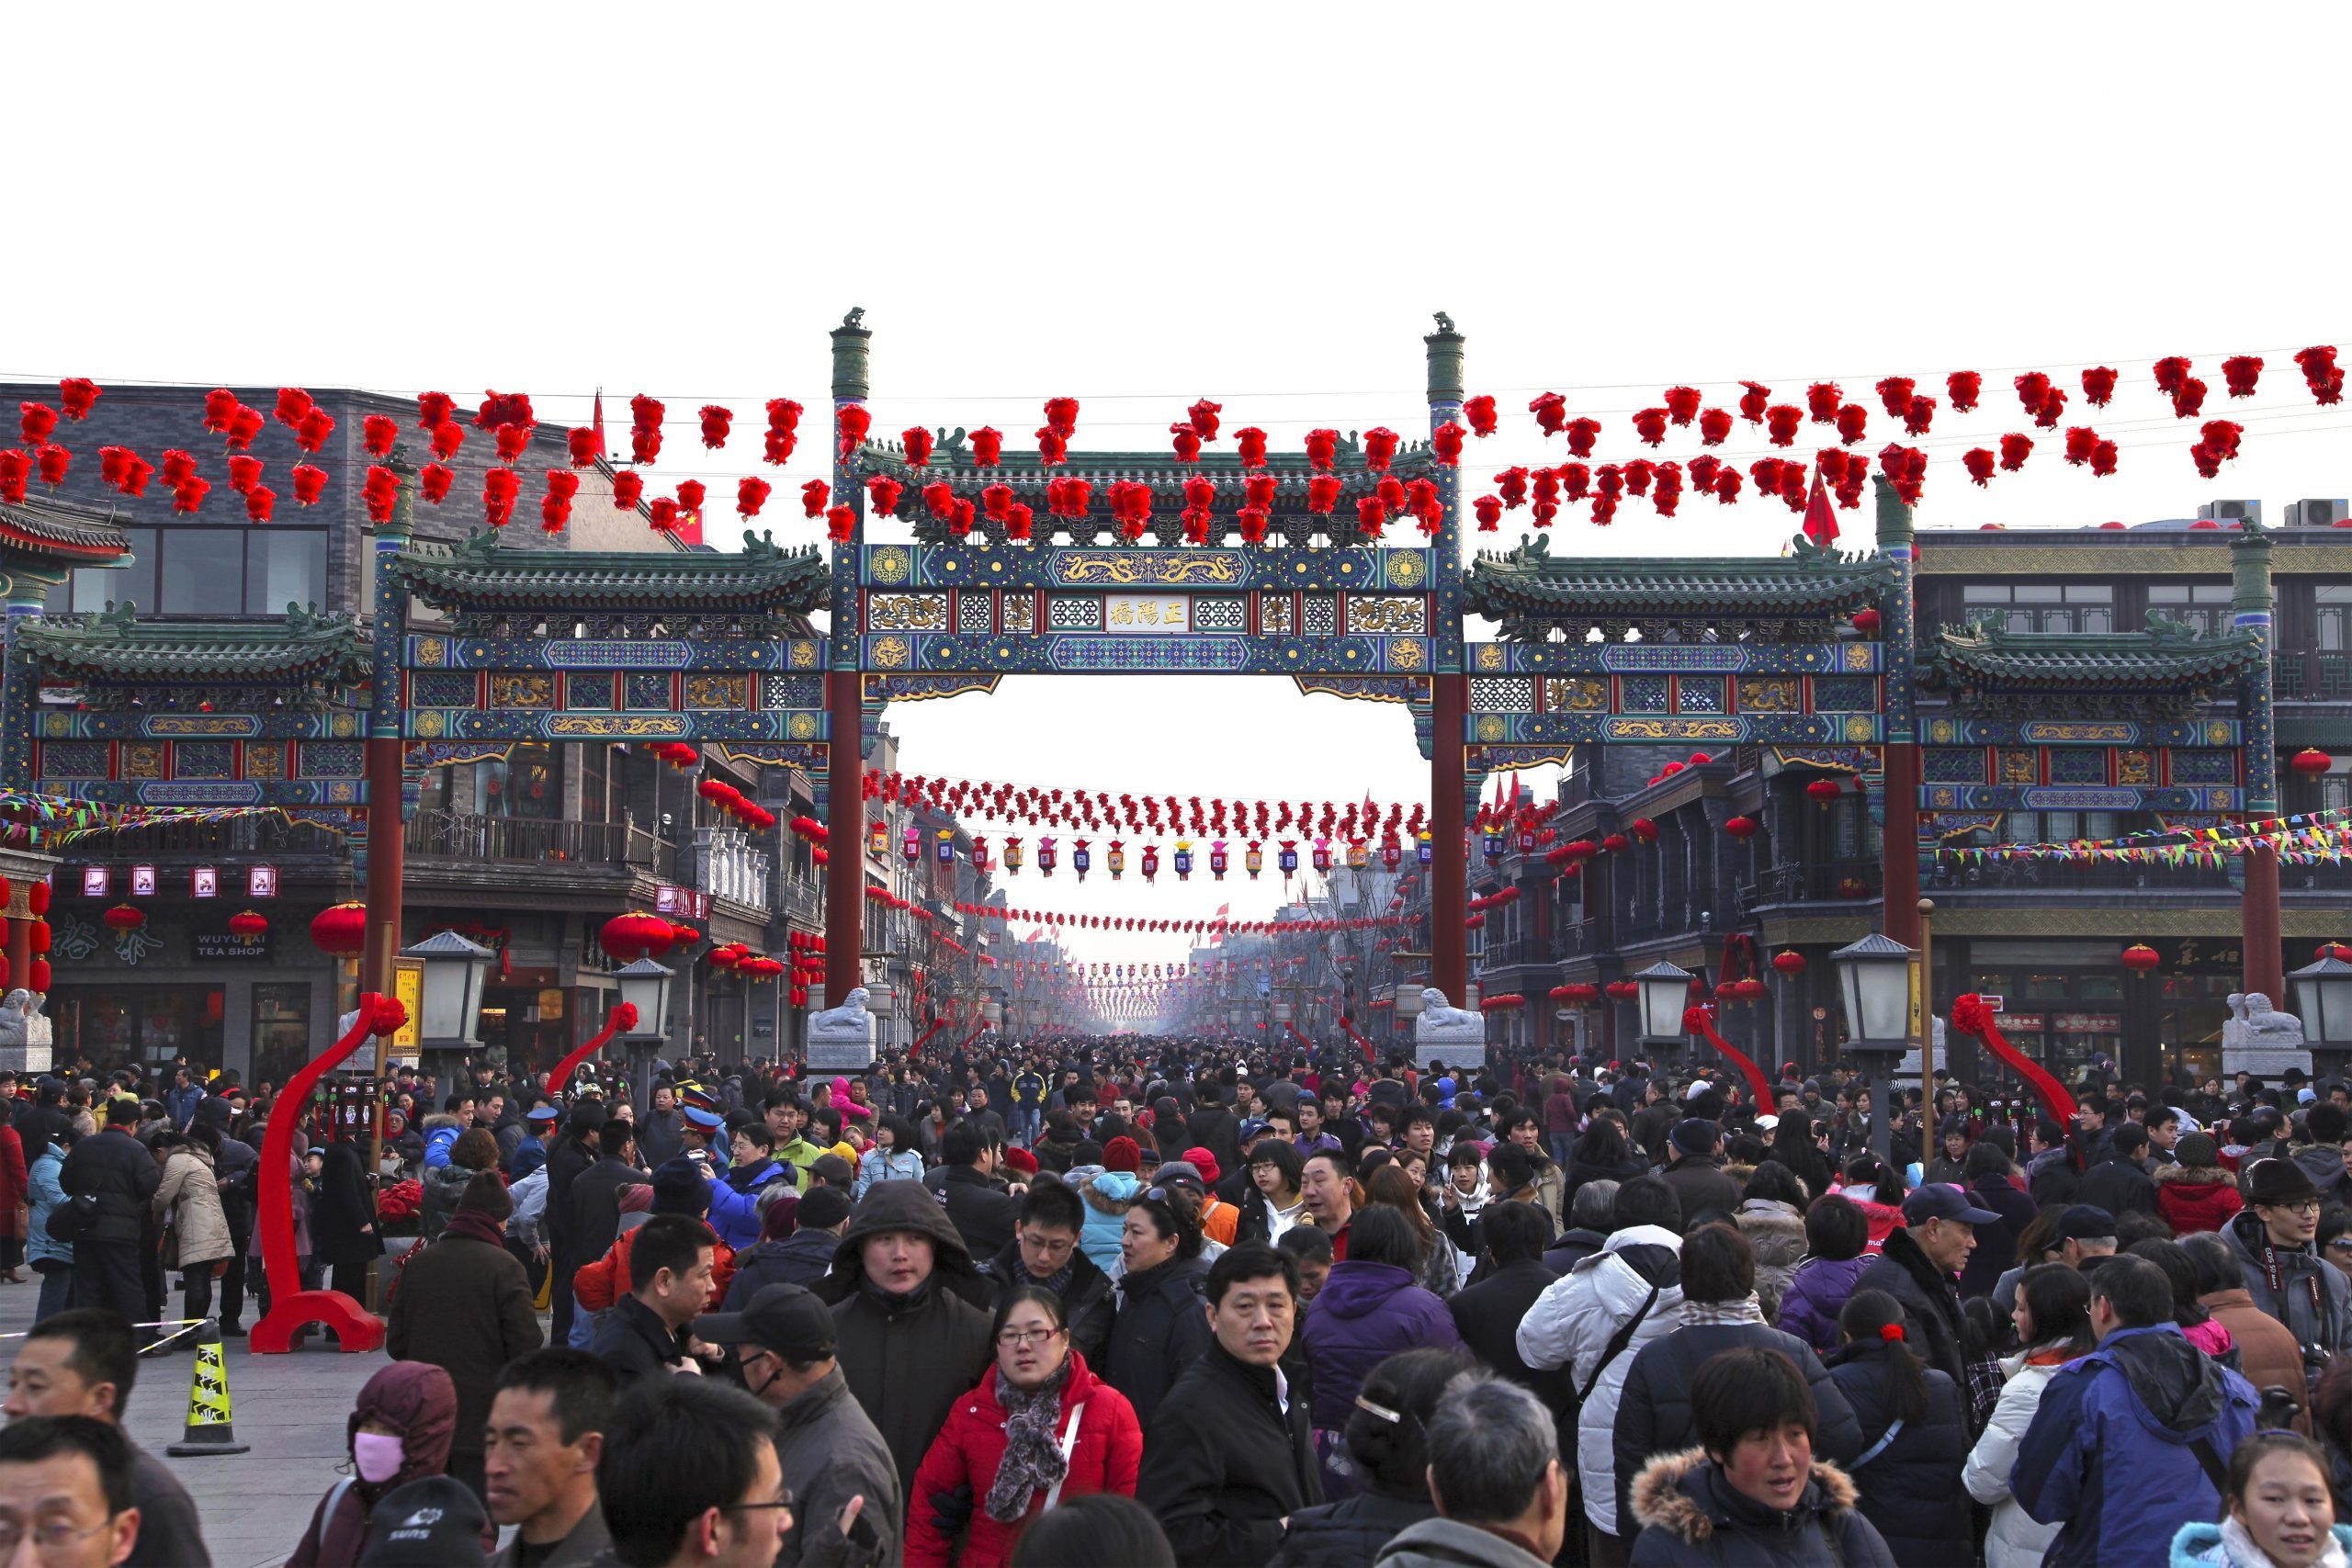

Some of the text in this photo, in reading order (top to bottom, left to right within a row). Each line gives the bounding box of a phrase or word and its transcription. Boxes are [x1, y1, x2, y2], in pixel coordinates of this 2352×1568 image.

[198, 935, 266, 943] WUYUAI
[198, 947, 265, 955] TEA SHOP
[2265, 1247, 2275, 1264] EOS
